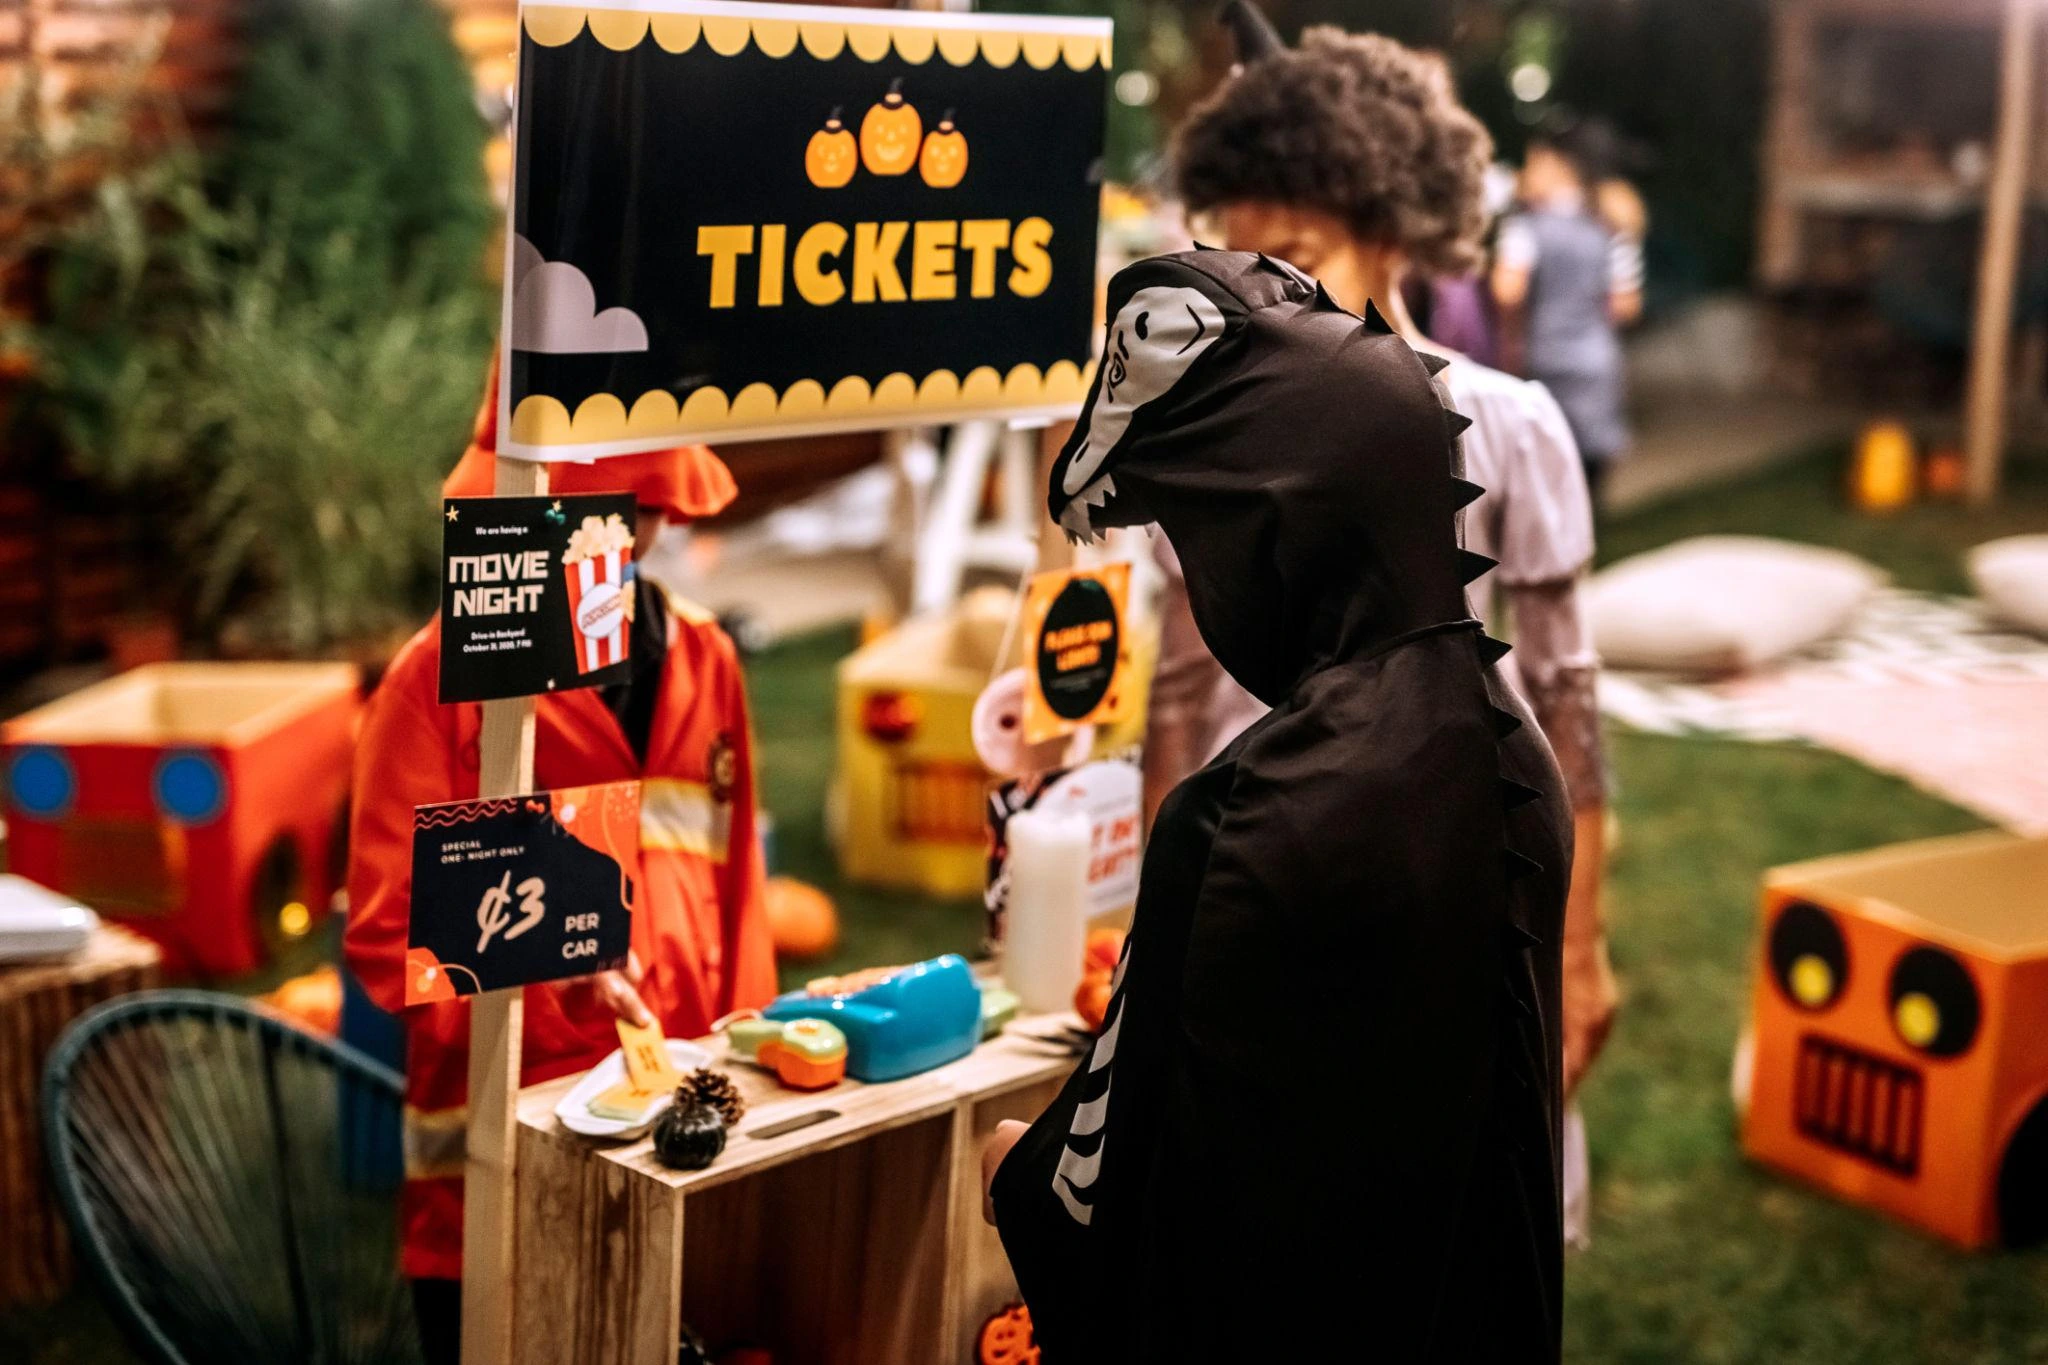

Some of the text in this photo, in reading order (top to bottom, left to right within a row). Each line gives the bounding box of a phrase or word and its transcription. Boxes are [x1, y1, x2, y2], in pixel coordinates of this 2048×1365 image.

[697, 216, 1054, 309] TICKETS
[475, 526, 487, 536] We
[487, 527, 500, 535] are
[500, 525, 522, 536] having
[449, 551, 550, 583] MOVIE
[453, 584, 544, 617] NIGHT
[496, 628, 526, 639] Backyard
[463, 643, 490, 653] October
[442, 840, 481, 852] SPECIAL
[468, 848, 498, 860] NIGHT
[499, 845, 525, 857] ONLY
[565, 912, 600, 933] PER
[562, 938, 599, 959] CAR
